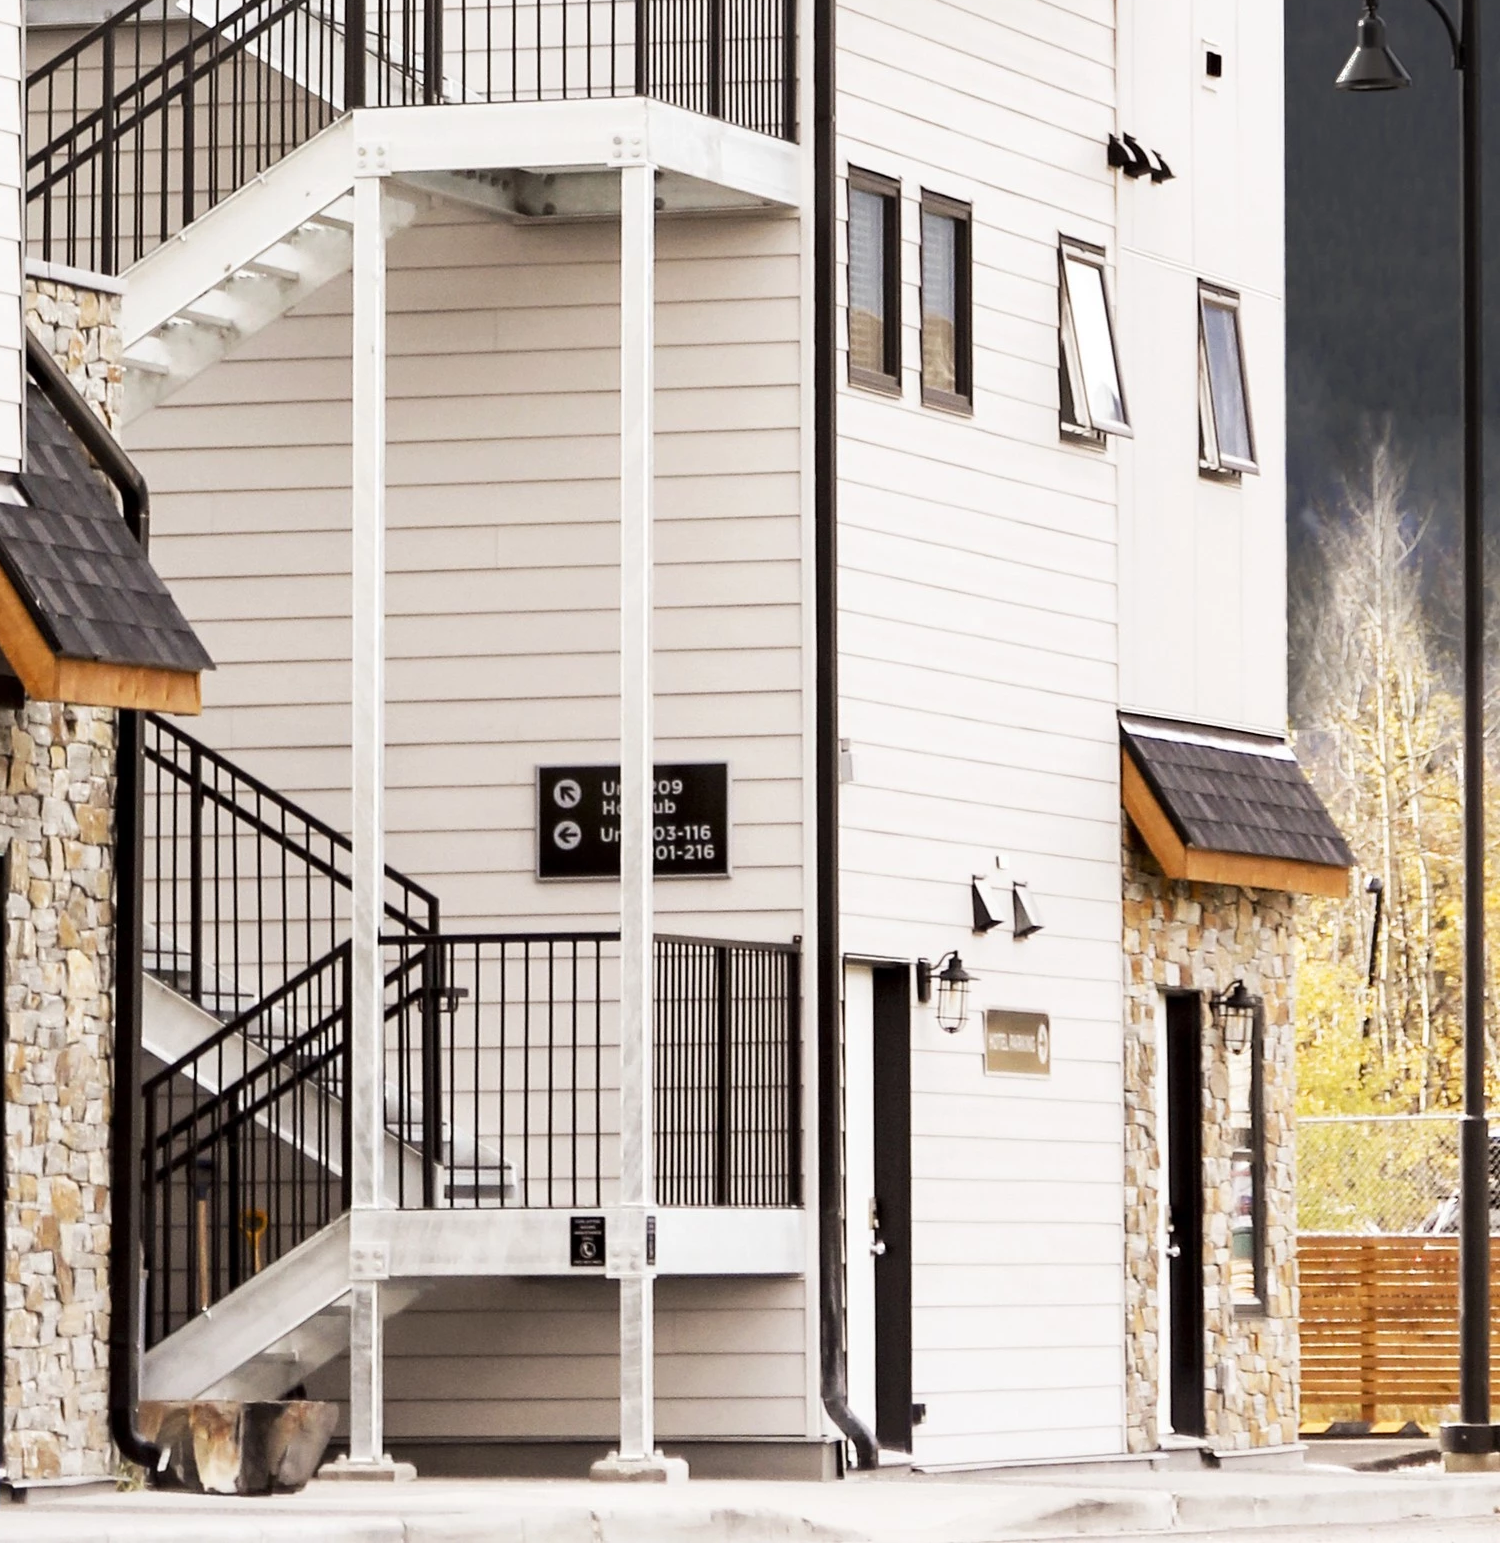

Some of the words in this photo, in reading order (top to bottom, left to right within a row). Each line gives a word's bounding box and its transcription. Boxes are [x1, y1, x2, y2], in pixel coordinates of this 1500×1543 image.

[653, 799, 676, 814] ub
[653, 825, 711, 841] 03-116
[653, 844, 715, 860] 01-216
